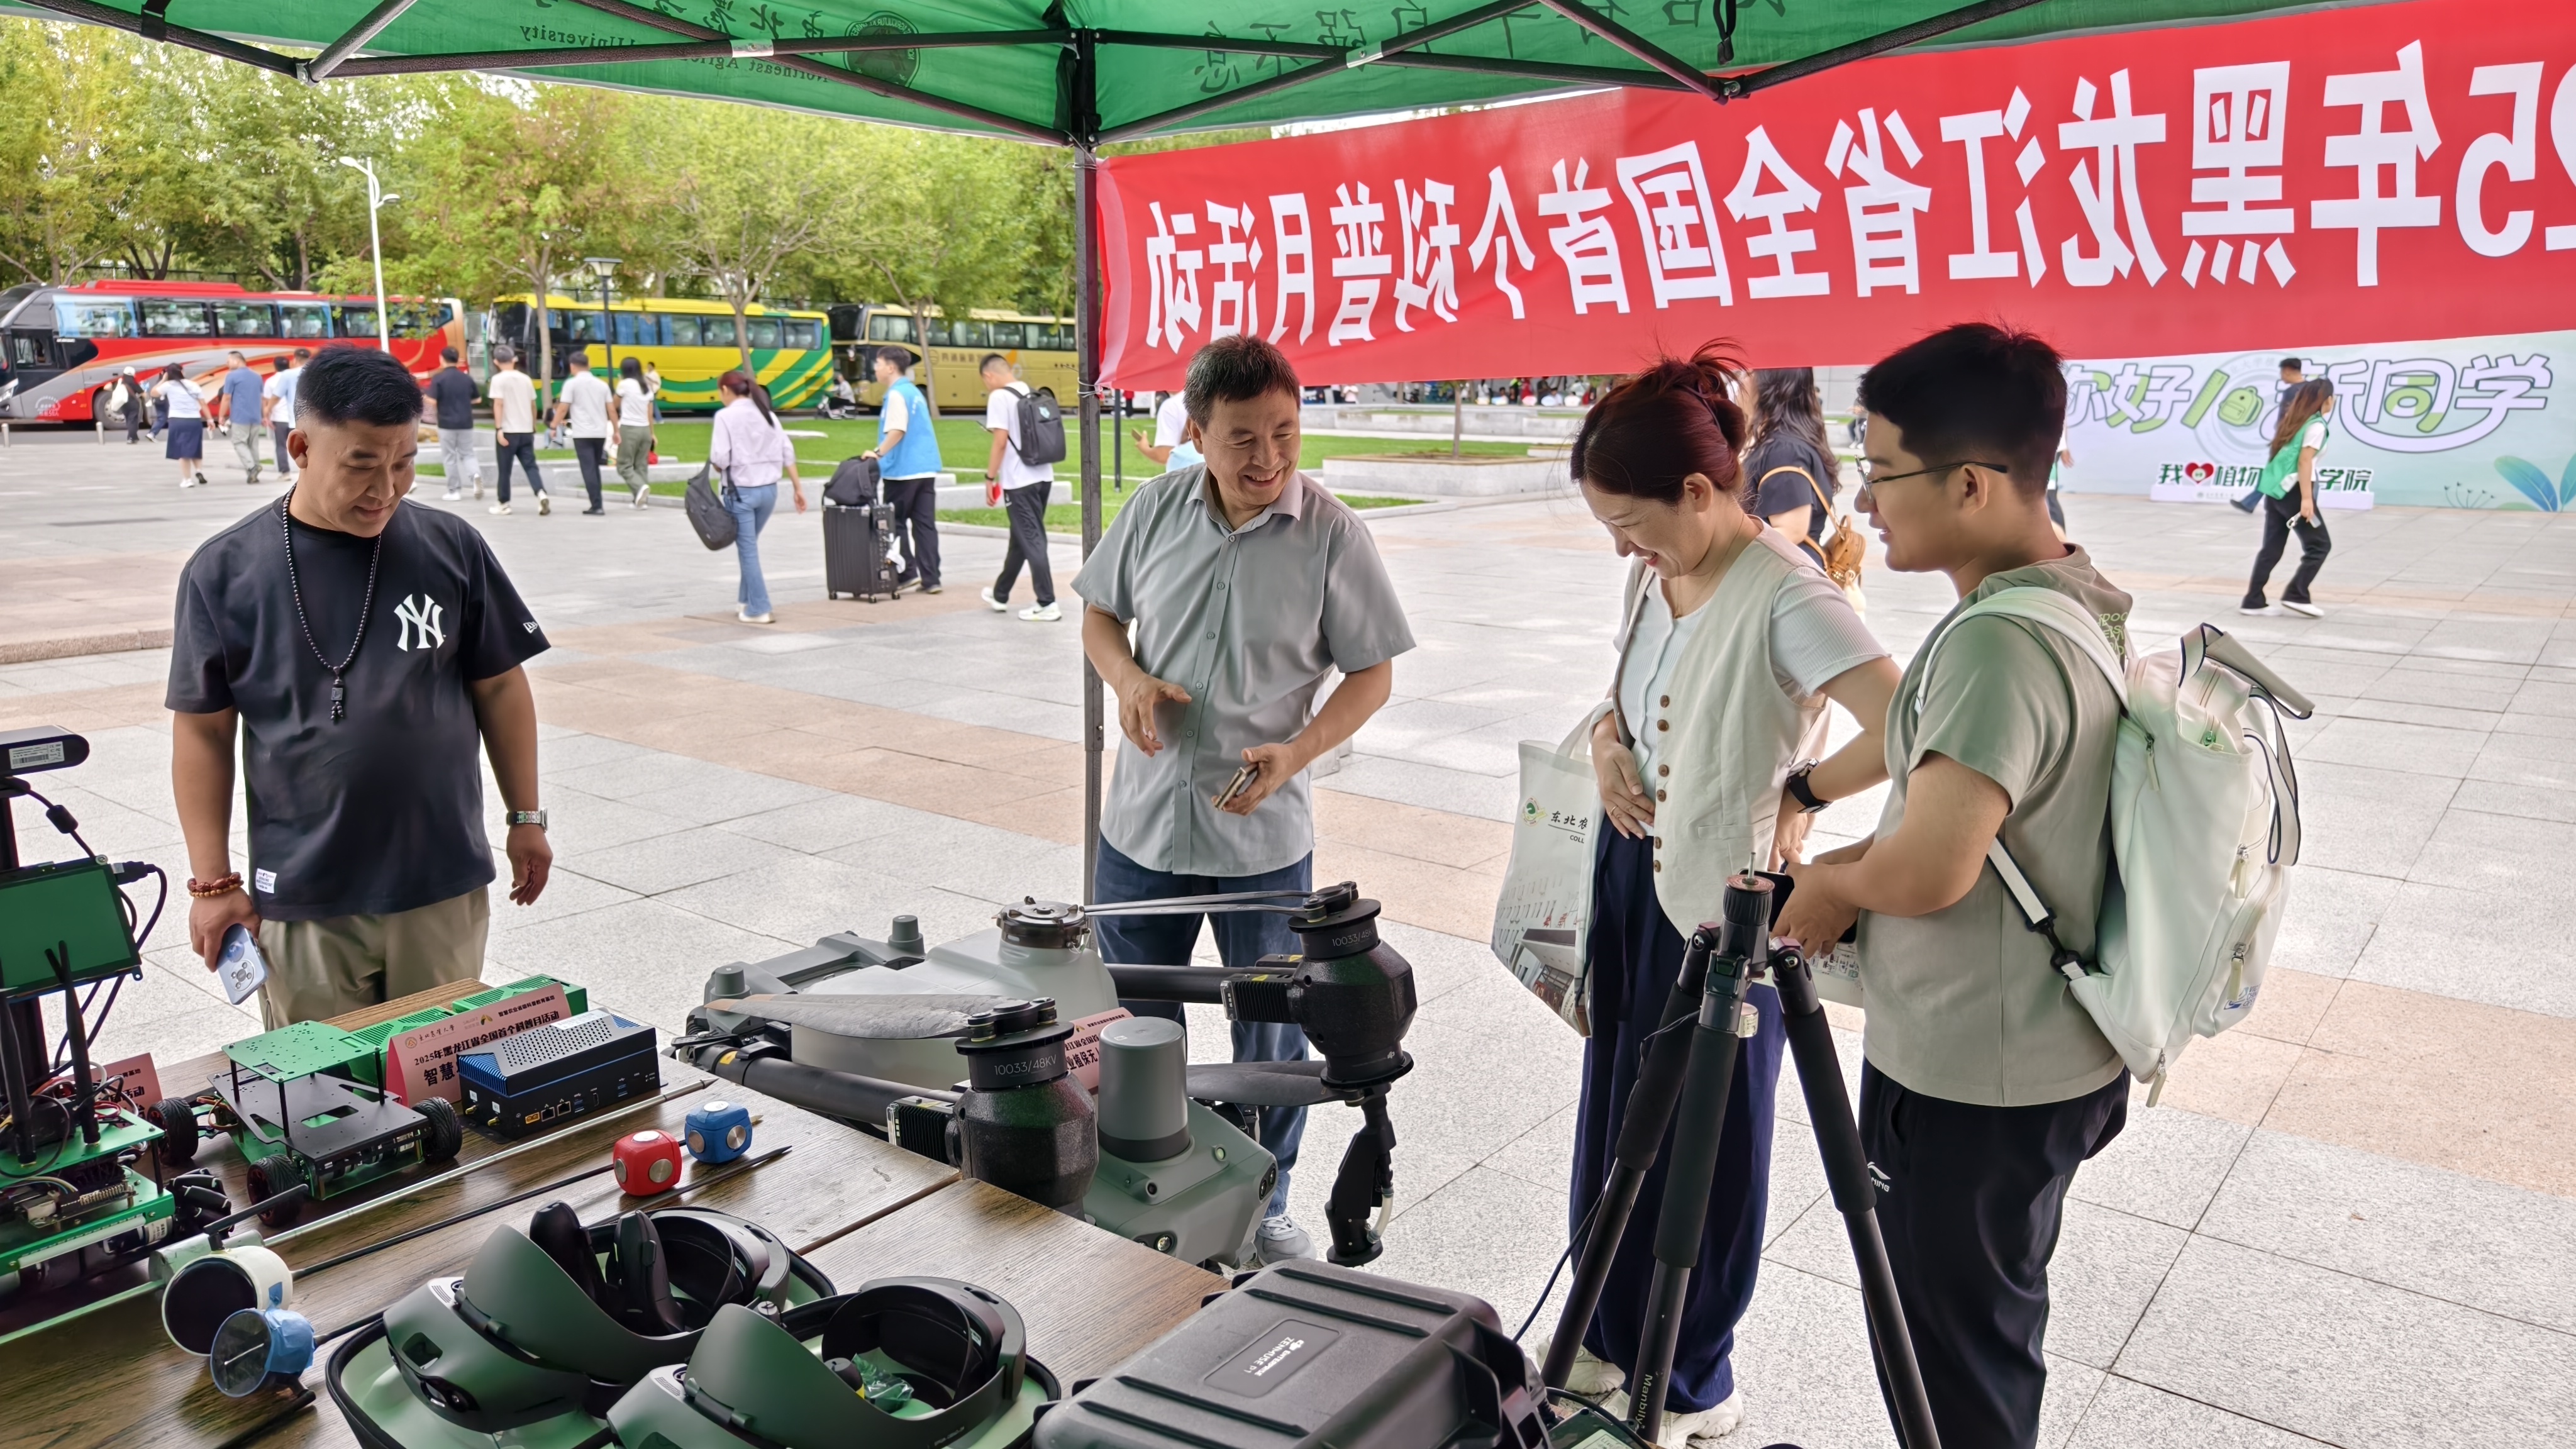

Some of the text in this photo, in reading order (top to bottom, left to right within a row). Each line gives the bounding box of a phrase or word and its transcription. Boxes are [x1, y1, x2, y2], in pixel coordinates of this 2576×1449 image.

[2158, 463, 2183, 485] 我
[1570, 835, 1584, 843] COLL
[423, 1061, 459, 1087] 智慧
[994, 1053, 1057, 1075] 10033/48KV
[1243, 1336, 1295, 1374] ZENMUSE P1
